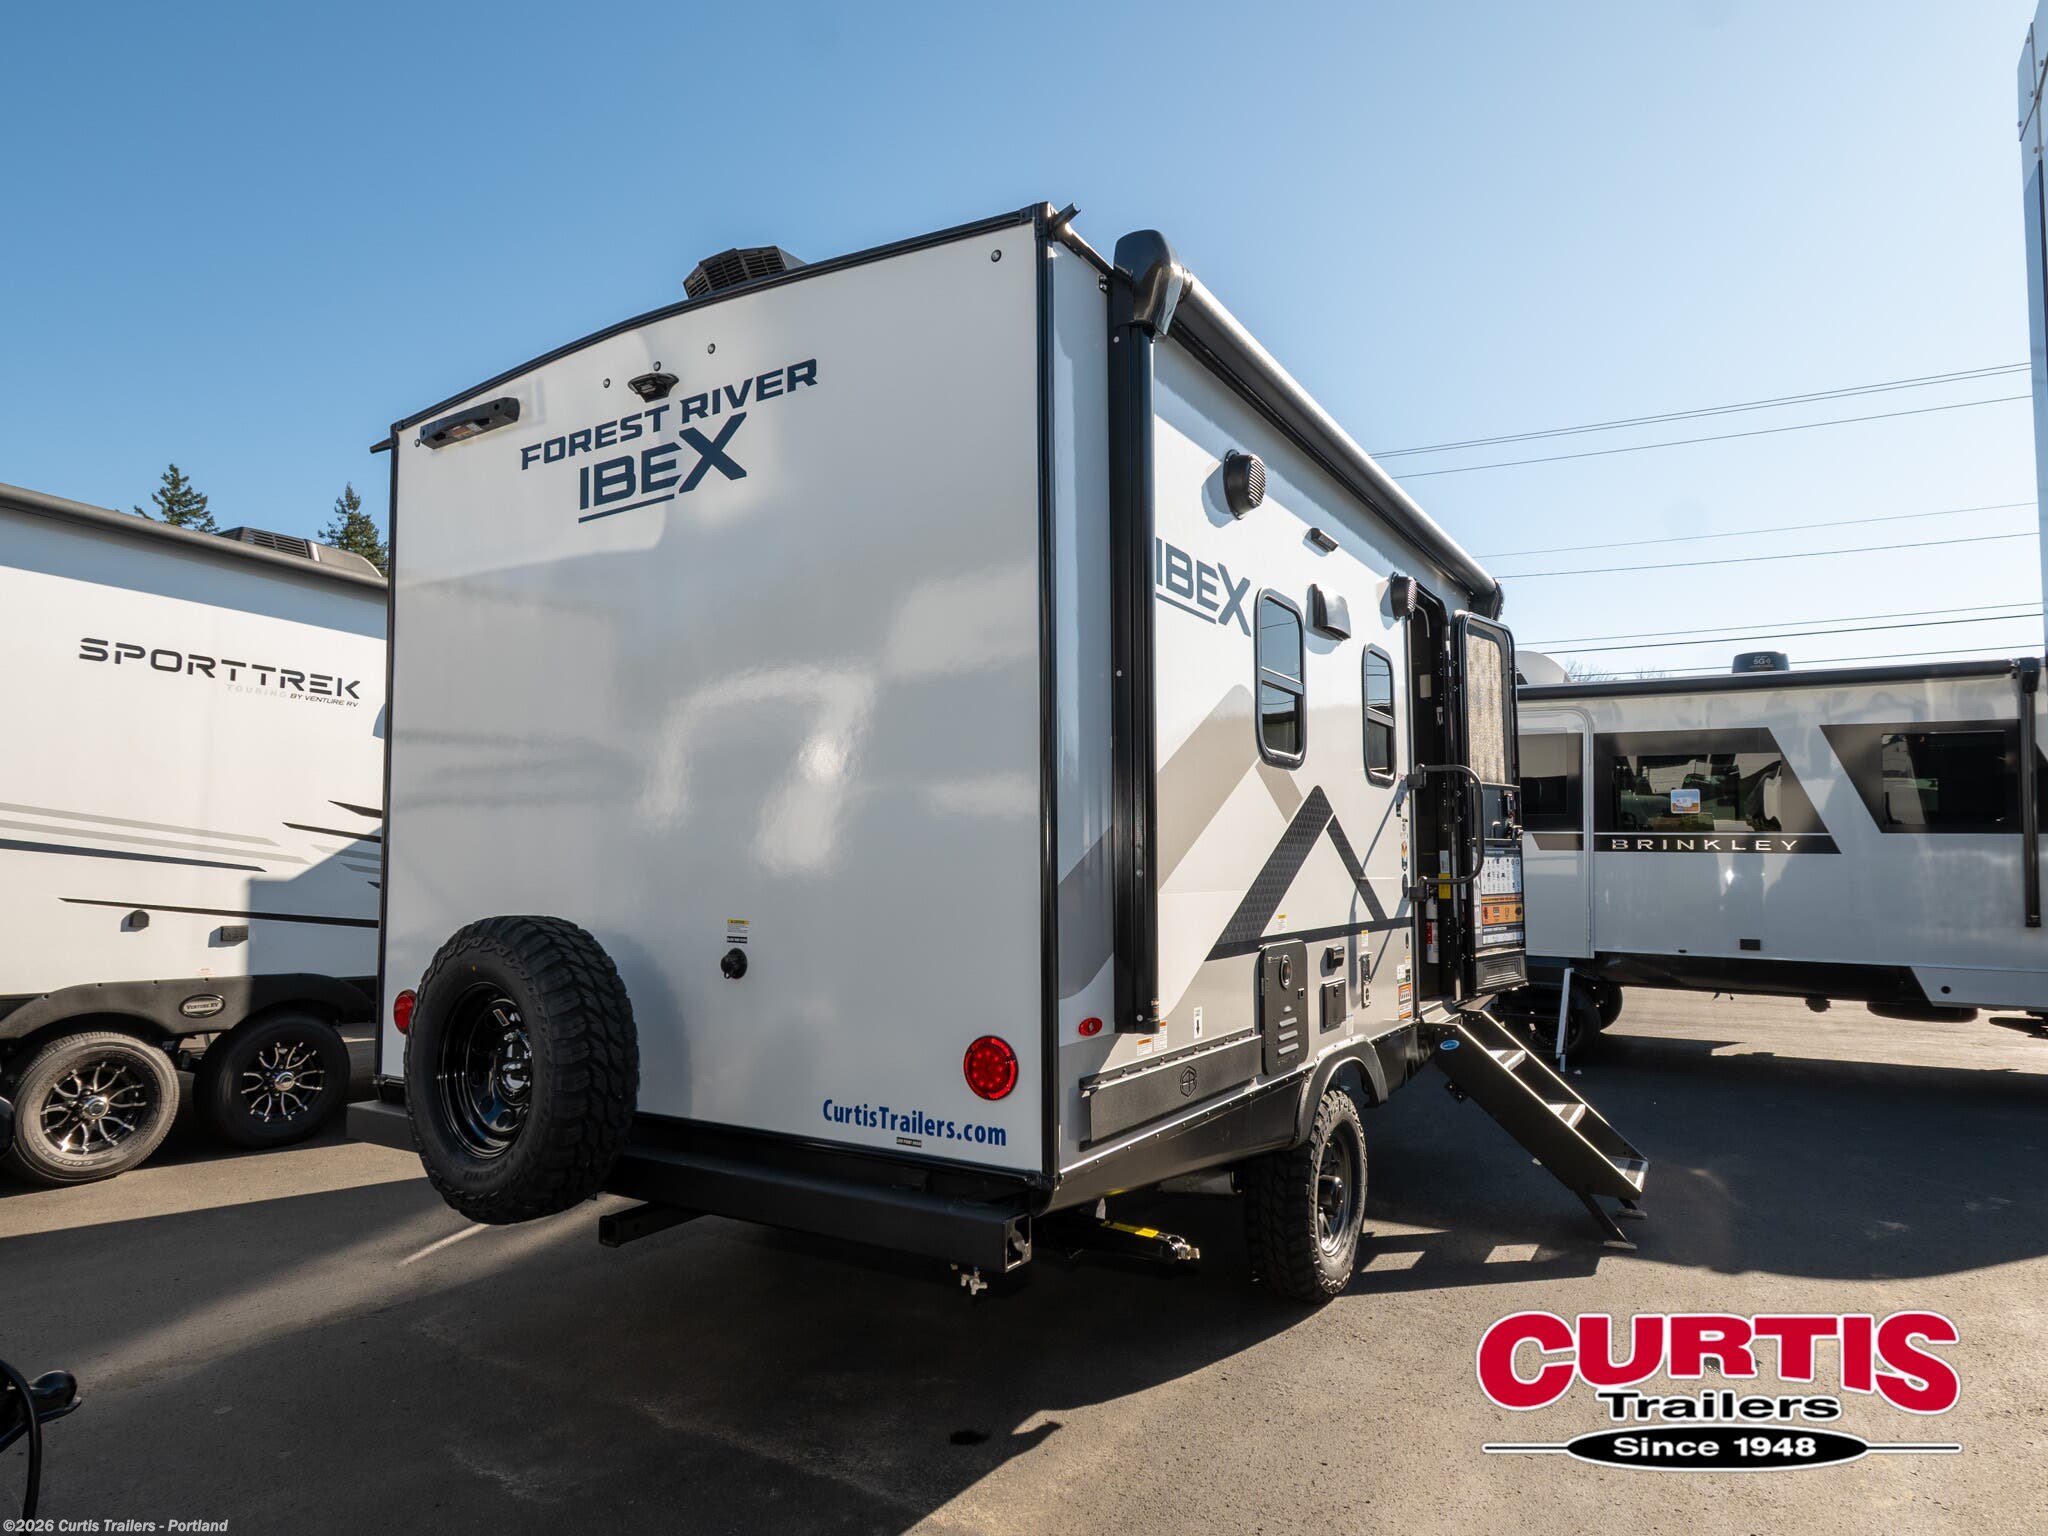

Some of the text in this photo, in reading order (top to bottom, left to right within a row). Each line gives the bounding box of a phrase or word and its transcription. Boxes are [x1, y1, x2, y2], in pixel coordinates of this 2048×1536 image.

[521, 358, 819, 470] FOREST RIVER
[578, 411, 748, 511] IBEX
[1155, 536, 1252, 638] IBEX
[79, 637, 361, 700] SPORTTREK
[226, 683, 288, 698] TOURING
[305, 695, 345, 706] VENTURE
[1611, 838, 1798, 851] BRINKLEY
[822, 1098, 1007, 1147] CurtisTrailers.com
